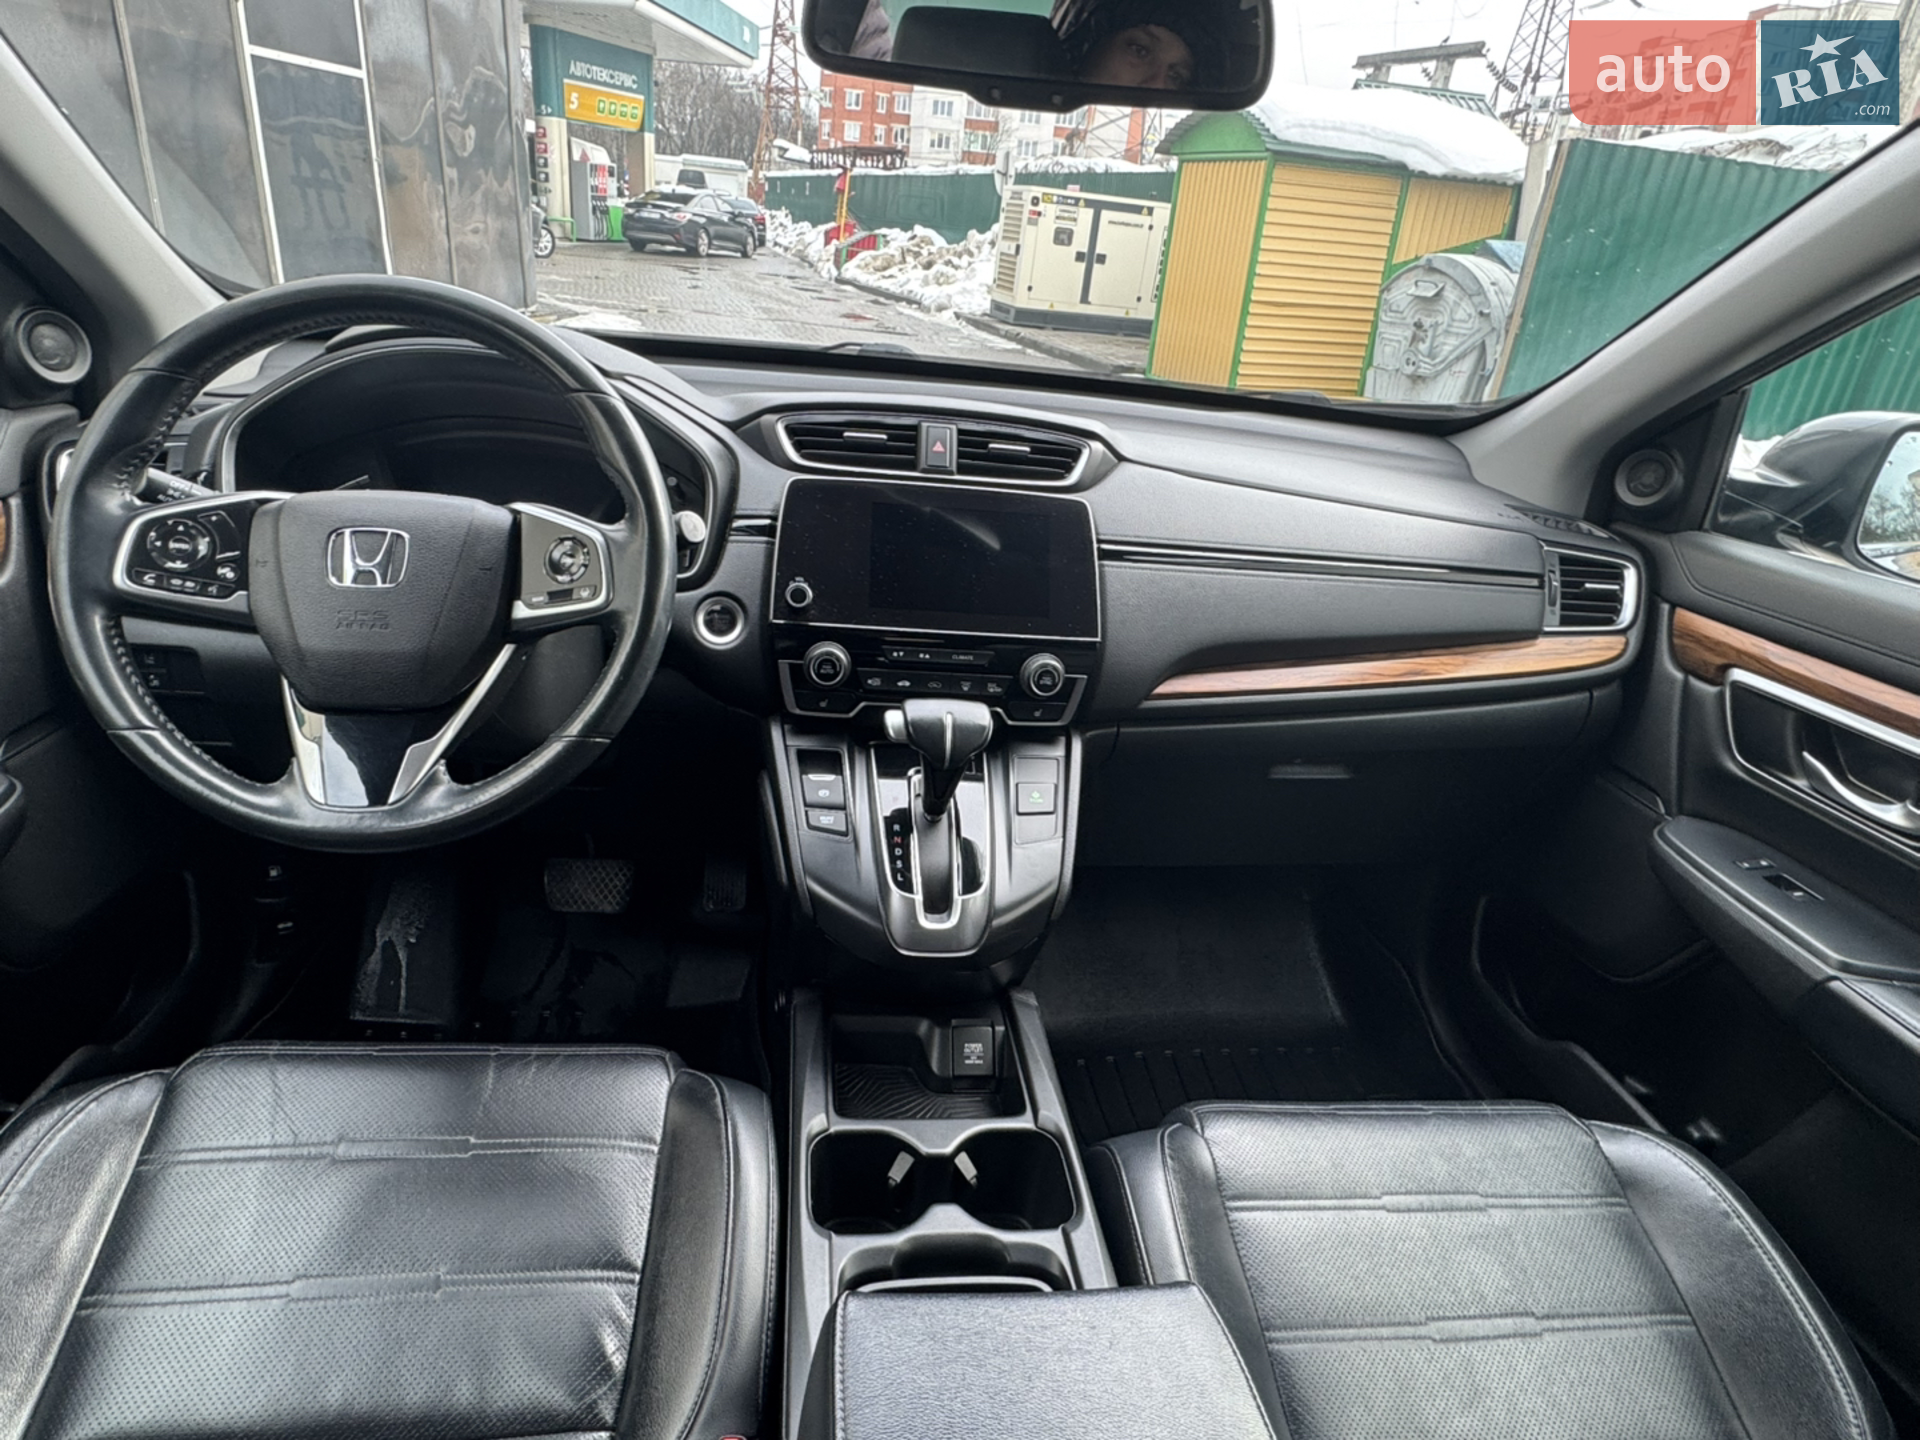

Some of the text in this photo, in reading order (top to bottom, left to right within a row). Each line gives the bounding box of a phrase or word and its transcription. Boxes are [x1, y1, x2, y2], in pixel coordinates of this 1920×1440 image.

[569, 92, 579, 109] 5
[893, 824, 901, 832] R
[894, 836, 902, 844] N
[895, 848, 903, 856] D
[896, 860, 903, 869] S
[897, 873, 904, 881] L
